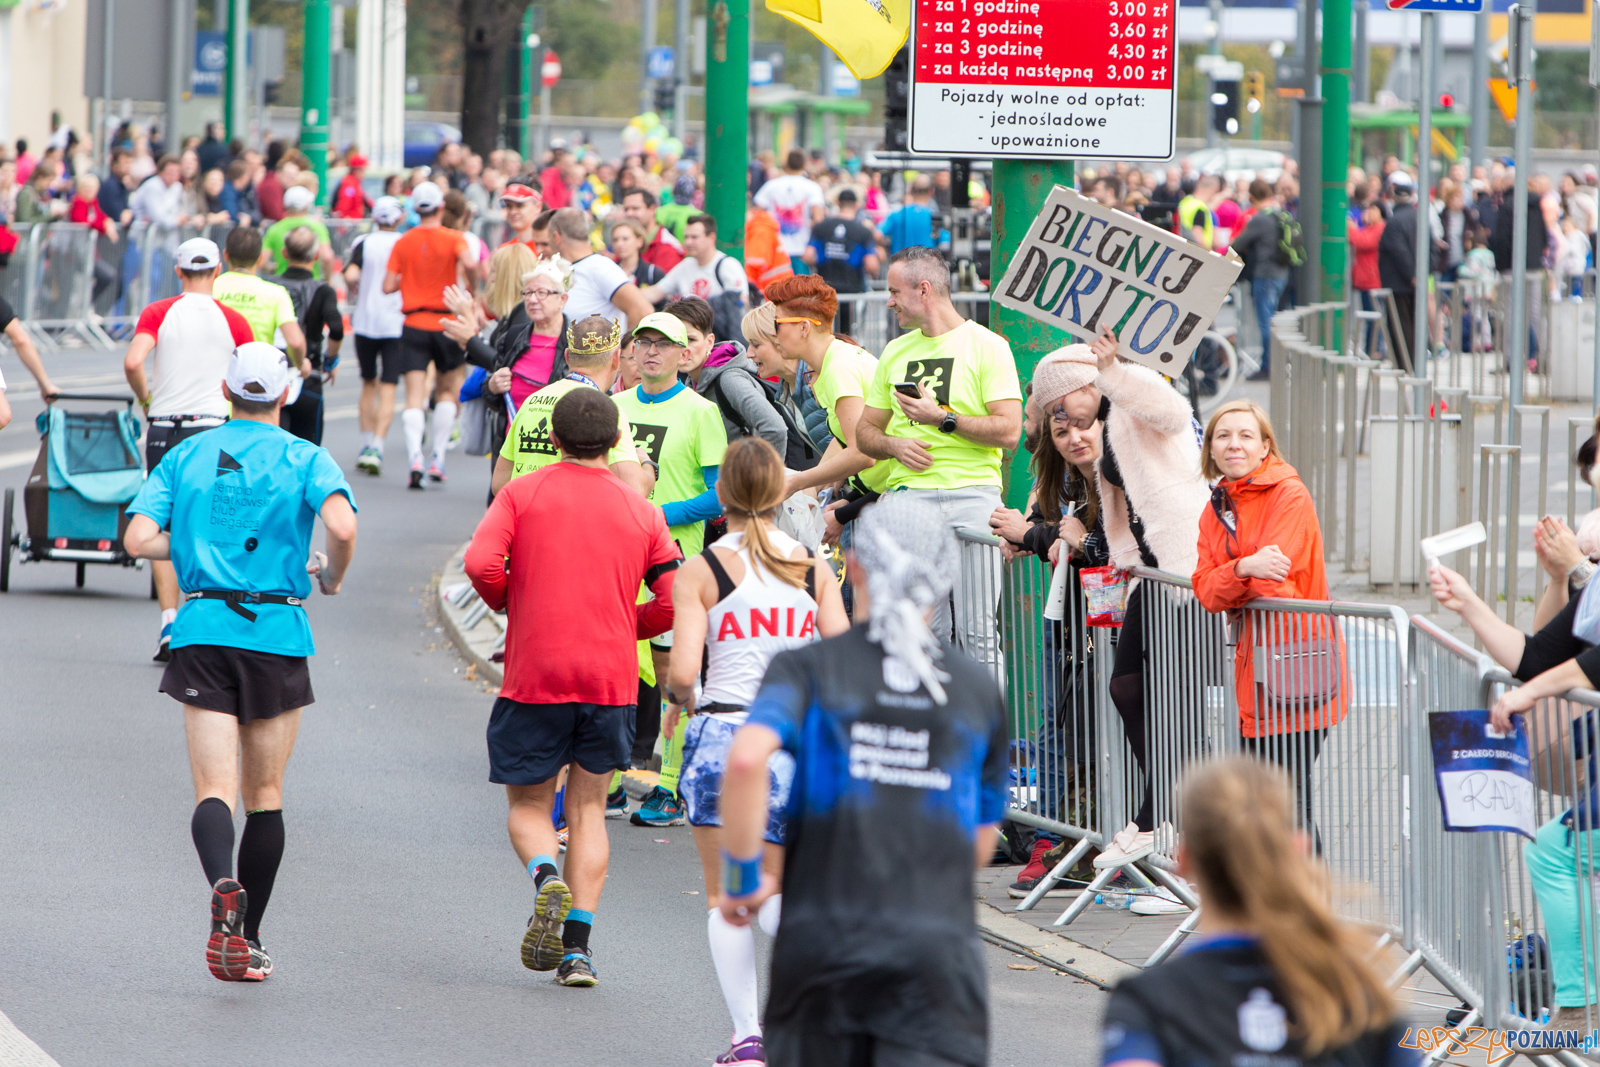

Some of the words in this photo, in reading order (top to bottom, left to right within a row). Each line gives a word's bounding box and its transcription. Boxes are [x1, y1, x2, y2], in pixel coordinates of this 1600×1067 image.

[935, 0, 954, 12] za
[960, 0, 967, 12] 1
[973, 0, 1040, 18] godzinę
[1108, 0, 1147, 18] 3,00
[1153, 2, 1169, 18] zł
[935, 21, 954, 33] za
[960, 18, 971, 33] 2
[976, 19, 1044, 39] godzinę
[1109, 21, 1146, 39] 3,60
[1152, 23, 1169, 39] zł
[934, 42, 953, 54] za
[959, 39, 970, 55] 3
[976, 40, 1043, 60] godzinę
[1108, 43, 1146, 60] 4,30
[1151, 44, 1168, 60] zł
[933, 64, 952, 75] za
[959, 60, 1009, 81] każdą
[1015, 63, 1094, 83] następną
[1106, 64, 1145, 81] 3,00
[1151, 65, 1167, 81] zł
[941, 88, 1004, 108] Pojazdy
[1011, 90, 1060, 105] wolne
[1066, 92, 1087, 106] od
[1094, 93, 1145, 111] opłat:
[990, 110, 1107, 128] jednośladowe
[990, 133, 1101, 150] upoważnione
[1039, 203, 1204, 294] BIEGNIJ
[220, 292, 257, 304] JACEK
[1004, 245, 1202, 363] DORITO!
[214, 482, 253, 498] tempo
[210, 503, 237, 516] klub
[717, 607, 815, 642] ANIA
[1460, 749, 1495, 759] CAŁEGO
